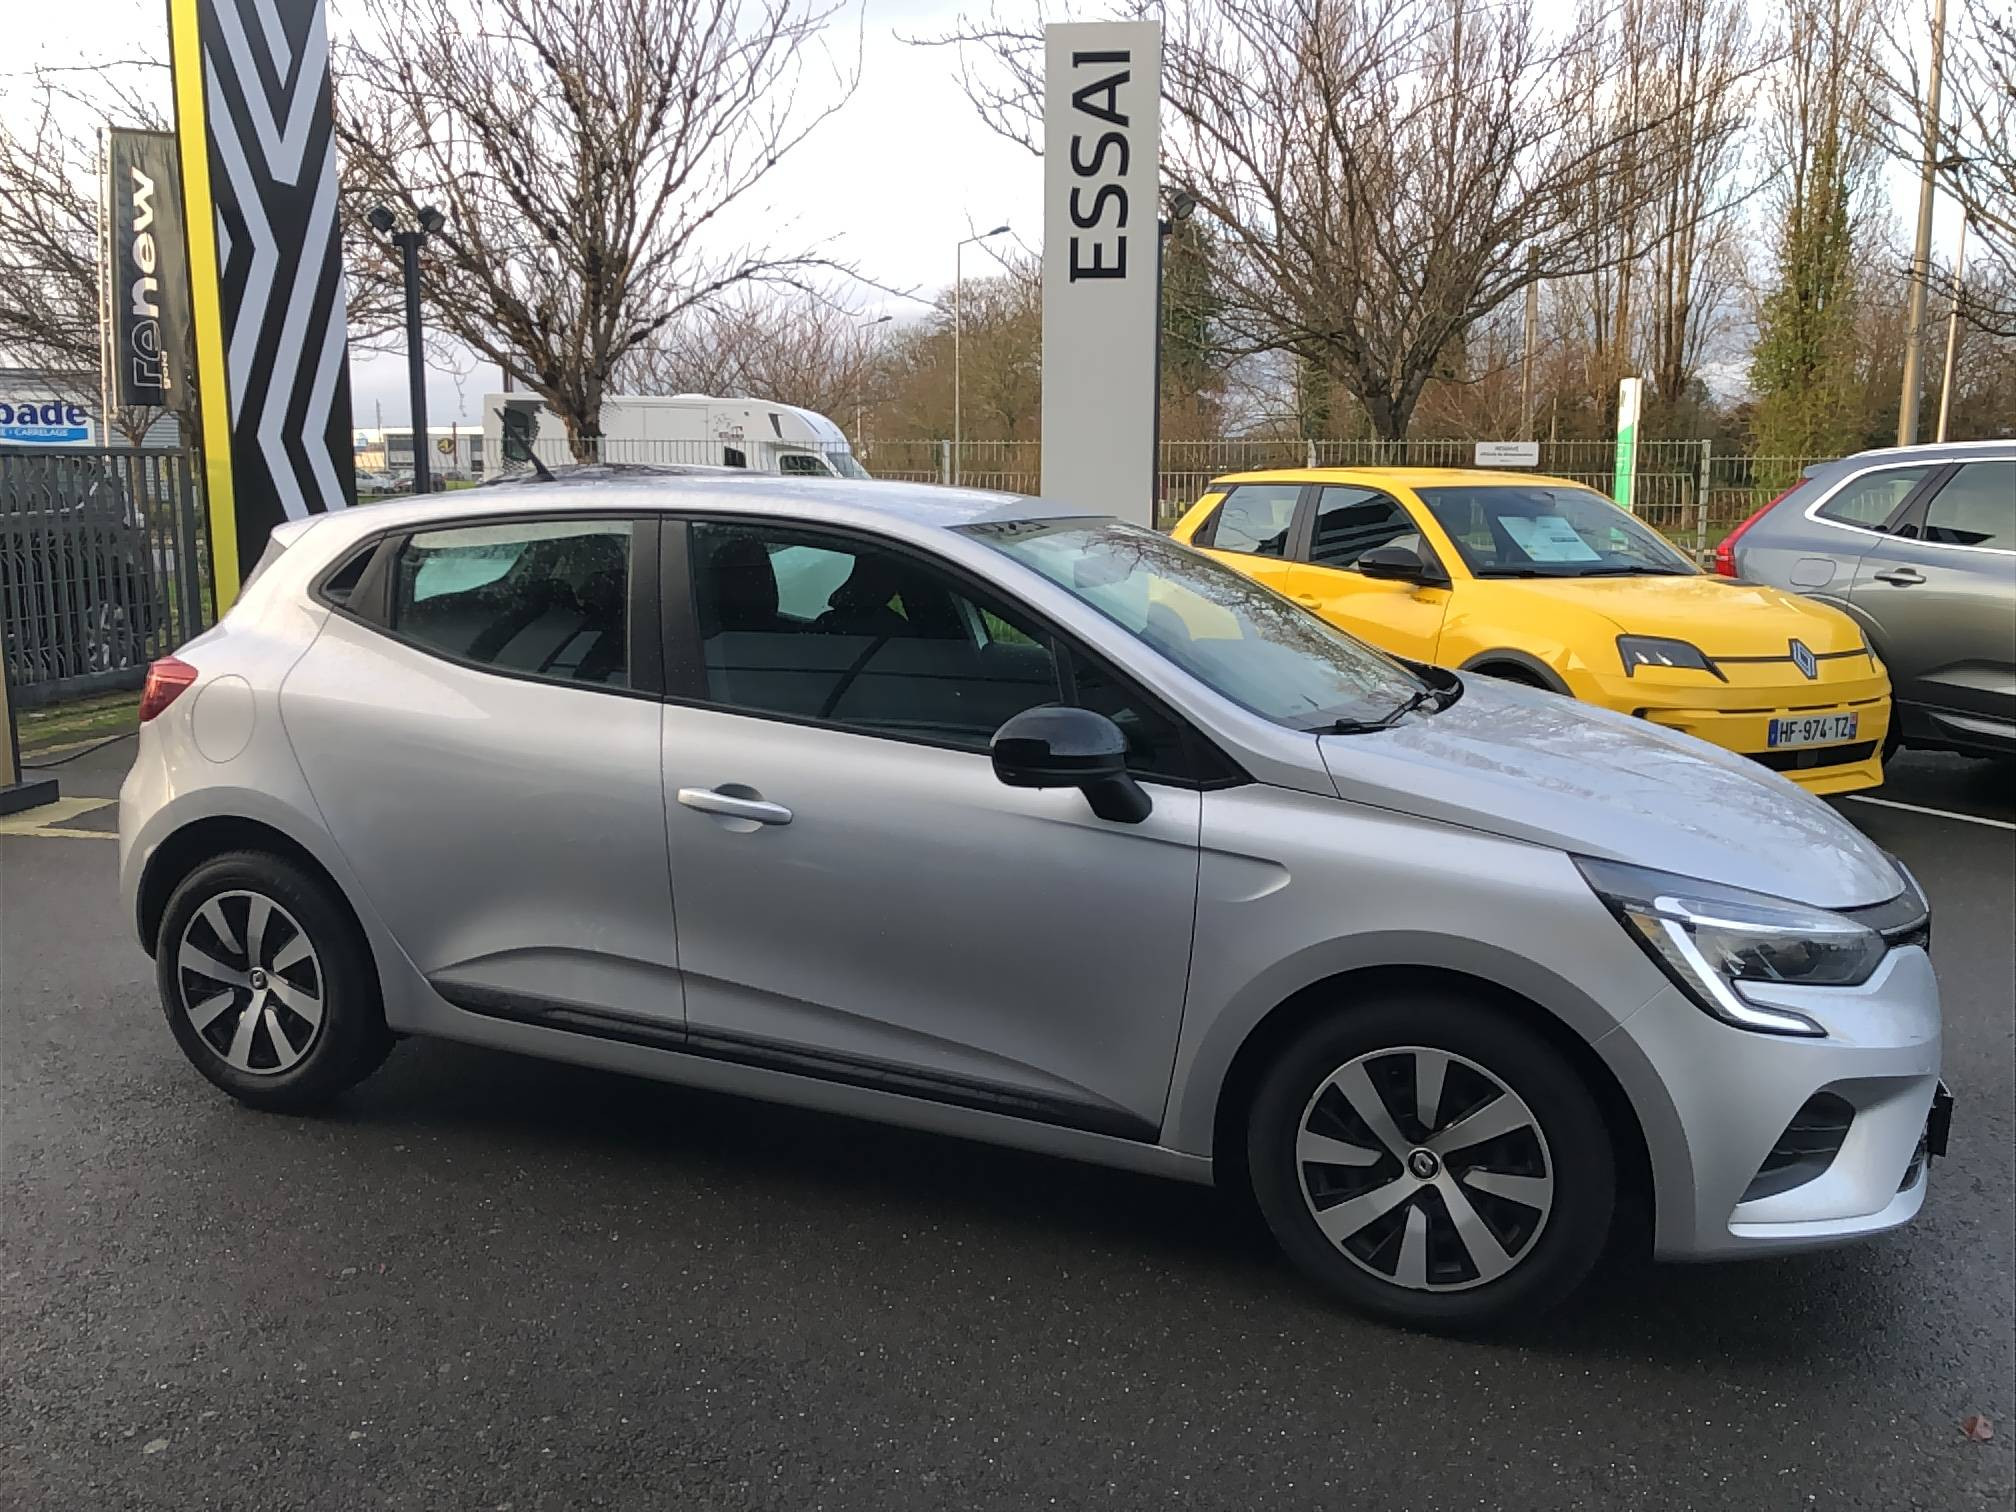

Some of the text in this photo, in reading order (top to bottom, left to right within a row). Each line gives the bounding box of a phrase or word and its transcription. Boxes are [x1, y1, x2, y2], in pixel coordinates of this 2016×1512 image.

[131, 166, 163, 388] renew
[1070, 50, 1131, 283] ESSAI
[1780, 716, 1849, 743] HF-974-TZ
